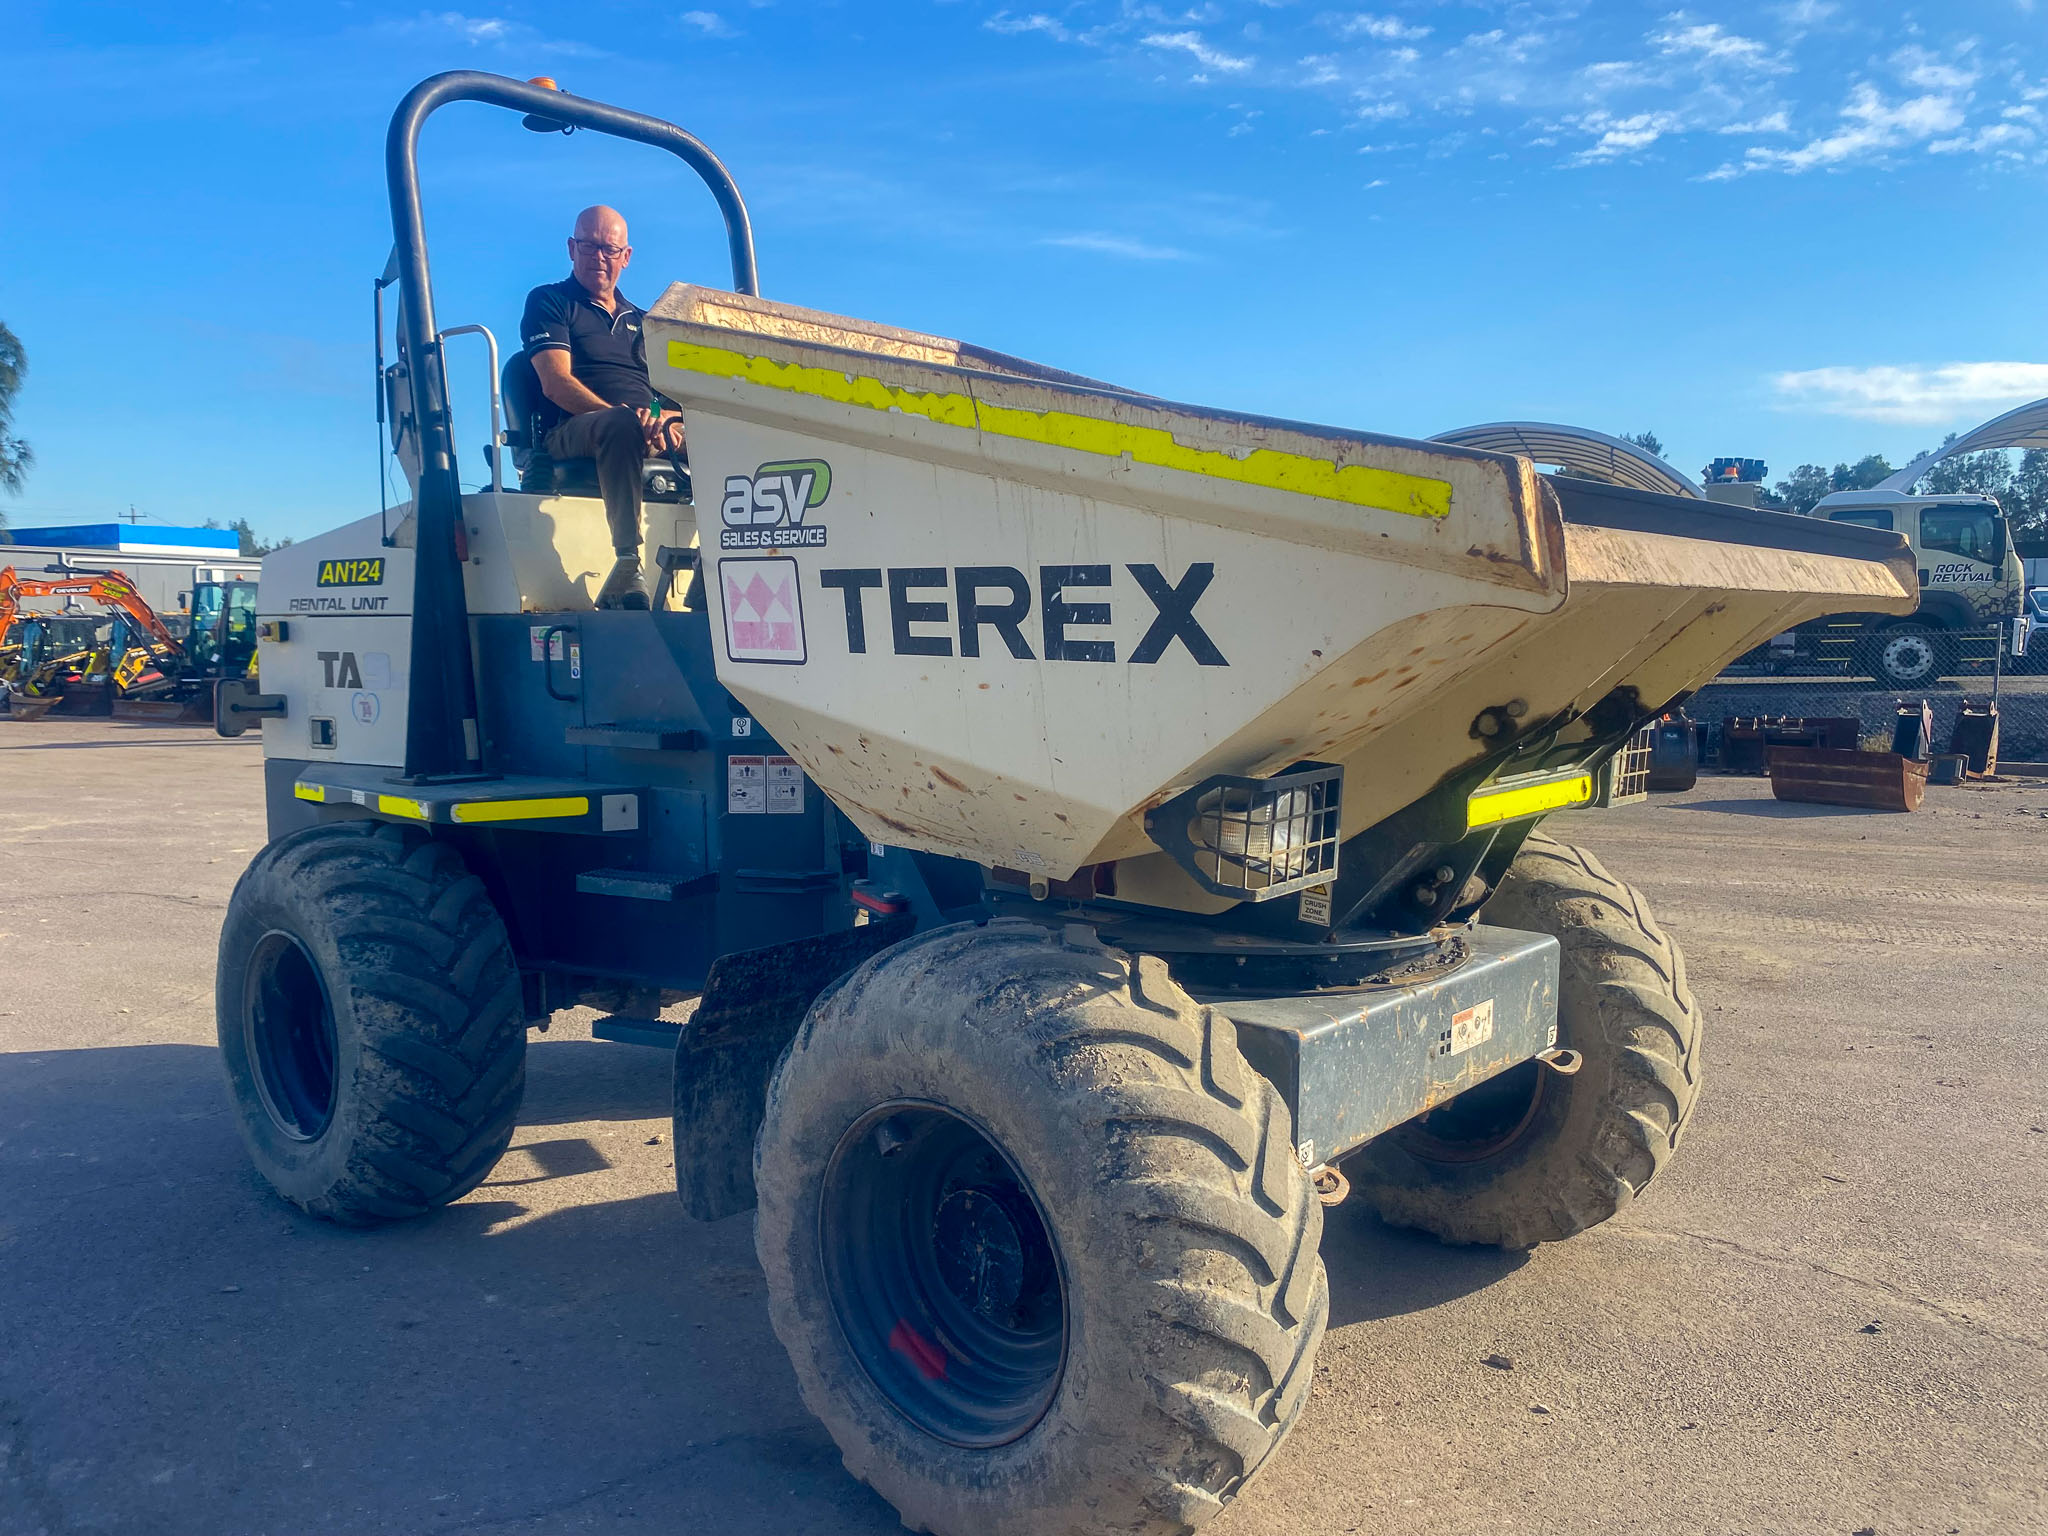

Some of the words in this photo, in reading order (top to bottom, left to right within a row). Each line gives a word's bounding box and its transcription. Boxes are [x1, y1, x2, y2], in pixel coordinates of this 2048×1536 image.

[760, 530, 771, 545] &
[773, 528, 825, 545] SERVICE
[320, 560, 380, 584] AN124
[1935, 563, 1975, 574] ROCK
[1932, 572, 1993, 583] REVIVAL
[289, 597, 346, 611] RENTAL
[352, 596, 389, 610] UNIT
[820, 562, 1230, 667] TEREX
[317, 651, 363, 688] TA
[1304, 900, 1327, 909] CRUSH
[1305, 907, 1324, 916] ZONE
